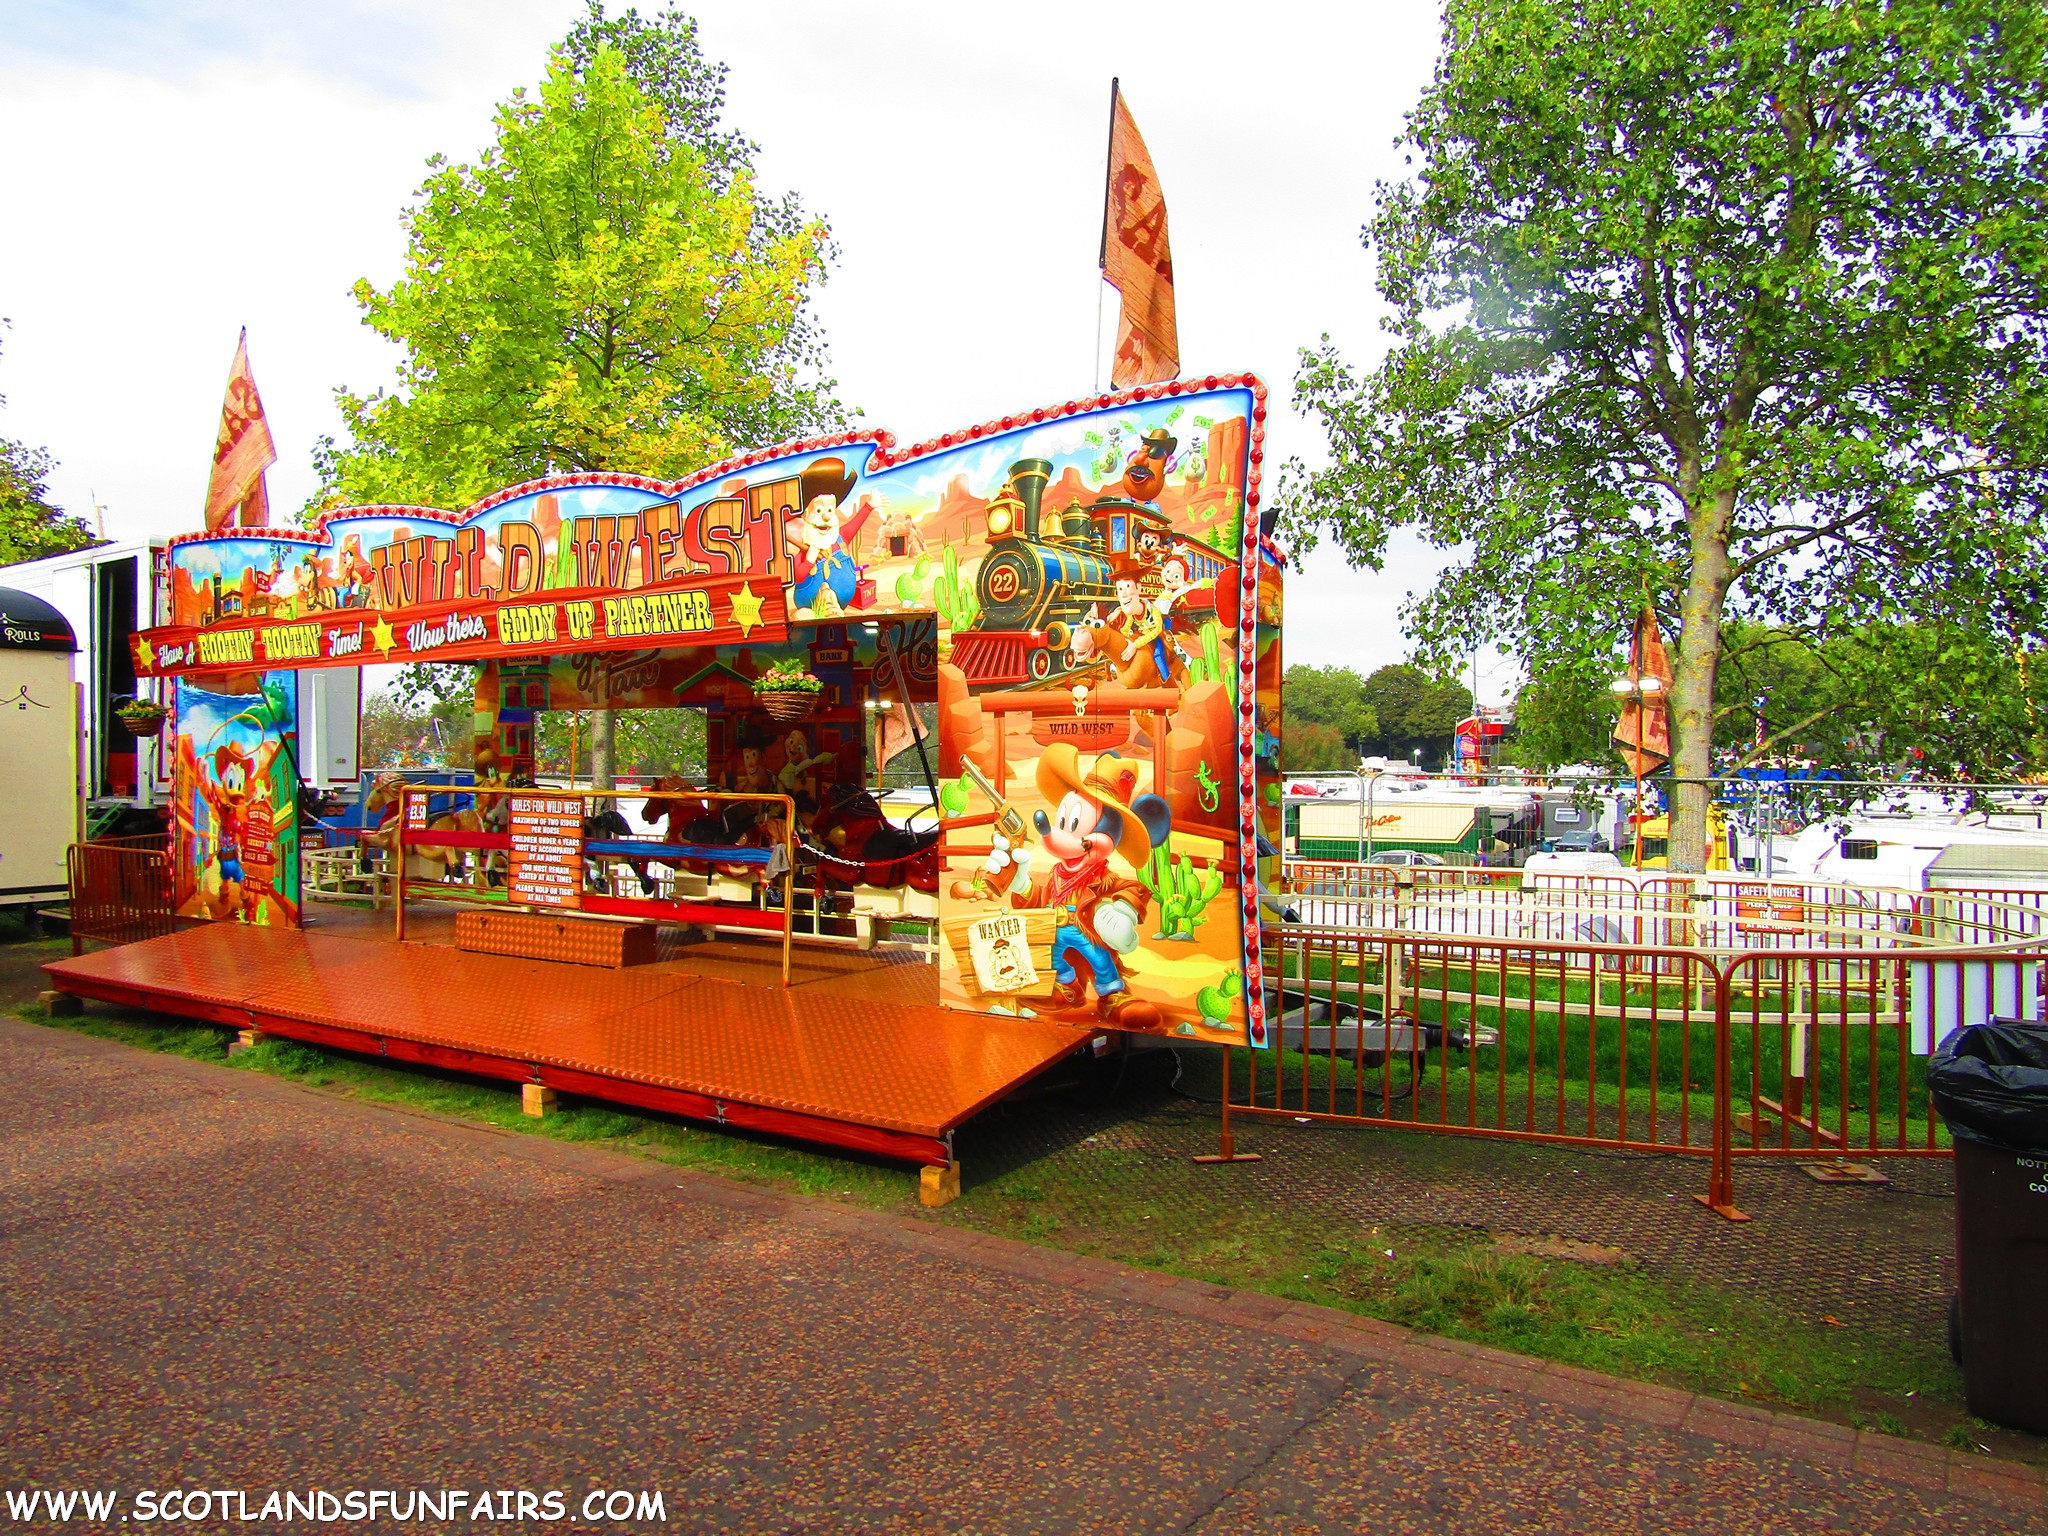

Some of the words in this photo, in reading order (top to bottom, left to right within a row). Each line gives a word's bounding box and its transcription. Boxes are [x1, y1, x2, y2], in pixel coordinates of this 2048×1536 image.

[370, 520, 544, 610] WILD
[572, 475, 804, 590] WEST
[993, 573, 1013, 593] 22
[863, 586, 875, 599] TNT
[406, 622, 445, 653] Wow
[444, 611, 488, 645] there,
[497, 600, 558, 646] GIDDY
[565, 597, 595, 641] UP
[604, 590, 714, 639] PARTNER
[159, 644, 184, 668] Have
[185, 641, 196, 665] A
[198, 628, 254, 664] ROOTIN'
[261, 622, 322, 660] TOOTIN'
[328, 621, 364, 658] Time!
[820, 652, 843, 661] BANK
[1049, 723, 1078, 735] WILD
[1081, 723, 1114, 735] WEST
[411, 794, 426, 802] FARE
[410, 805, 426, 820] £3.50
[512, 799, 531, 812] RULES
[532, 800, 545, 813] FOR
[546, 800, 562, 813] WILD
[564, 801, 581, 815] WEST
[512, 816, 539, 825] MAXIMUM
[548, 818, 559, 826] TWO
[560, 819, 580, 827] RIDERS
[531, 826, 542, 834] PER
[542, 827, 560, 835] HORSE
[511, 835, 538, 844] CHILDREN
[538, 836, 557, 845] UNDER
[562, 838, 580, 846] YEARS
[514, 844, 530, 852] MUST
[538, 845, 576, 855] ACCOMPANIED
[536, 853, 545, 861] AN
[545, 854, 562, 863] ADULT
[521, 863, 533, 871] YOU
[533, 864, 548, 873] MUST
[548, 865, 570, 874] REMAIN
[518, 872, 538, 880] SEATED
[538, 873, 546, 881] AT
[546, 874, 555, 882] ALL
[556, 875, 573, 884] TIMES
[515, 883, 534, 892] PLEASE
[535, 885, 549, 893] HOLD
[549, 886, 558, 894] ON
[559, 888, 574, 896] TIGHT
[1738, 885, 1768, 897] SAFETY
[1770, 886, 1801, 898] NOTICE
[527, 893, 534, 901] AT
[534, 894, 545, 902] ALL
[545, 895, 562, 904] TIMES
[978, 918, 1021, 940] WANTED
